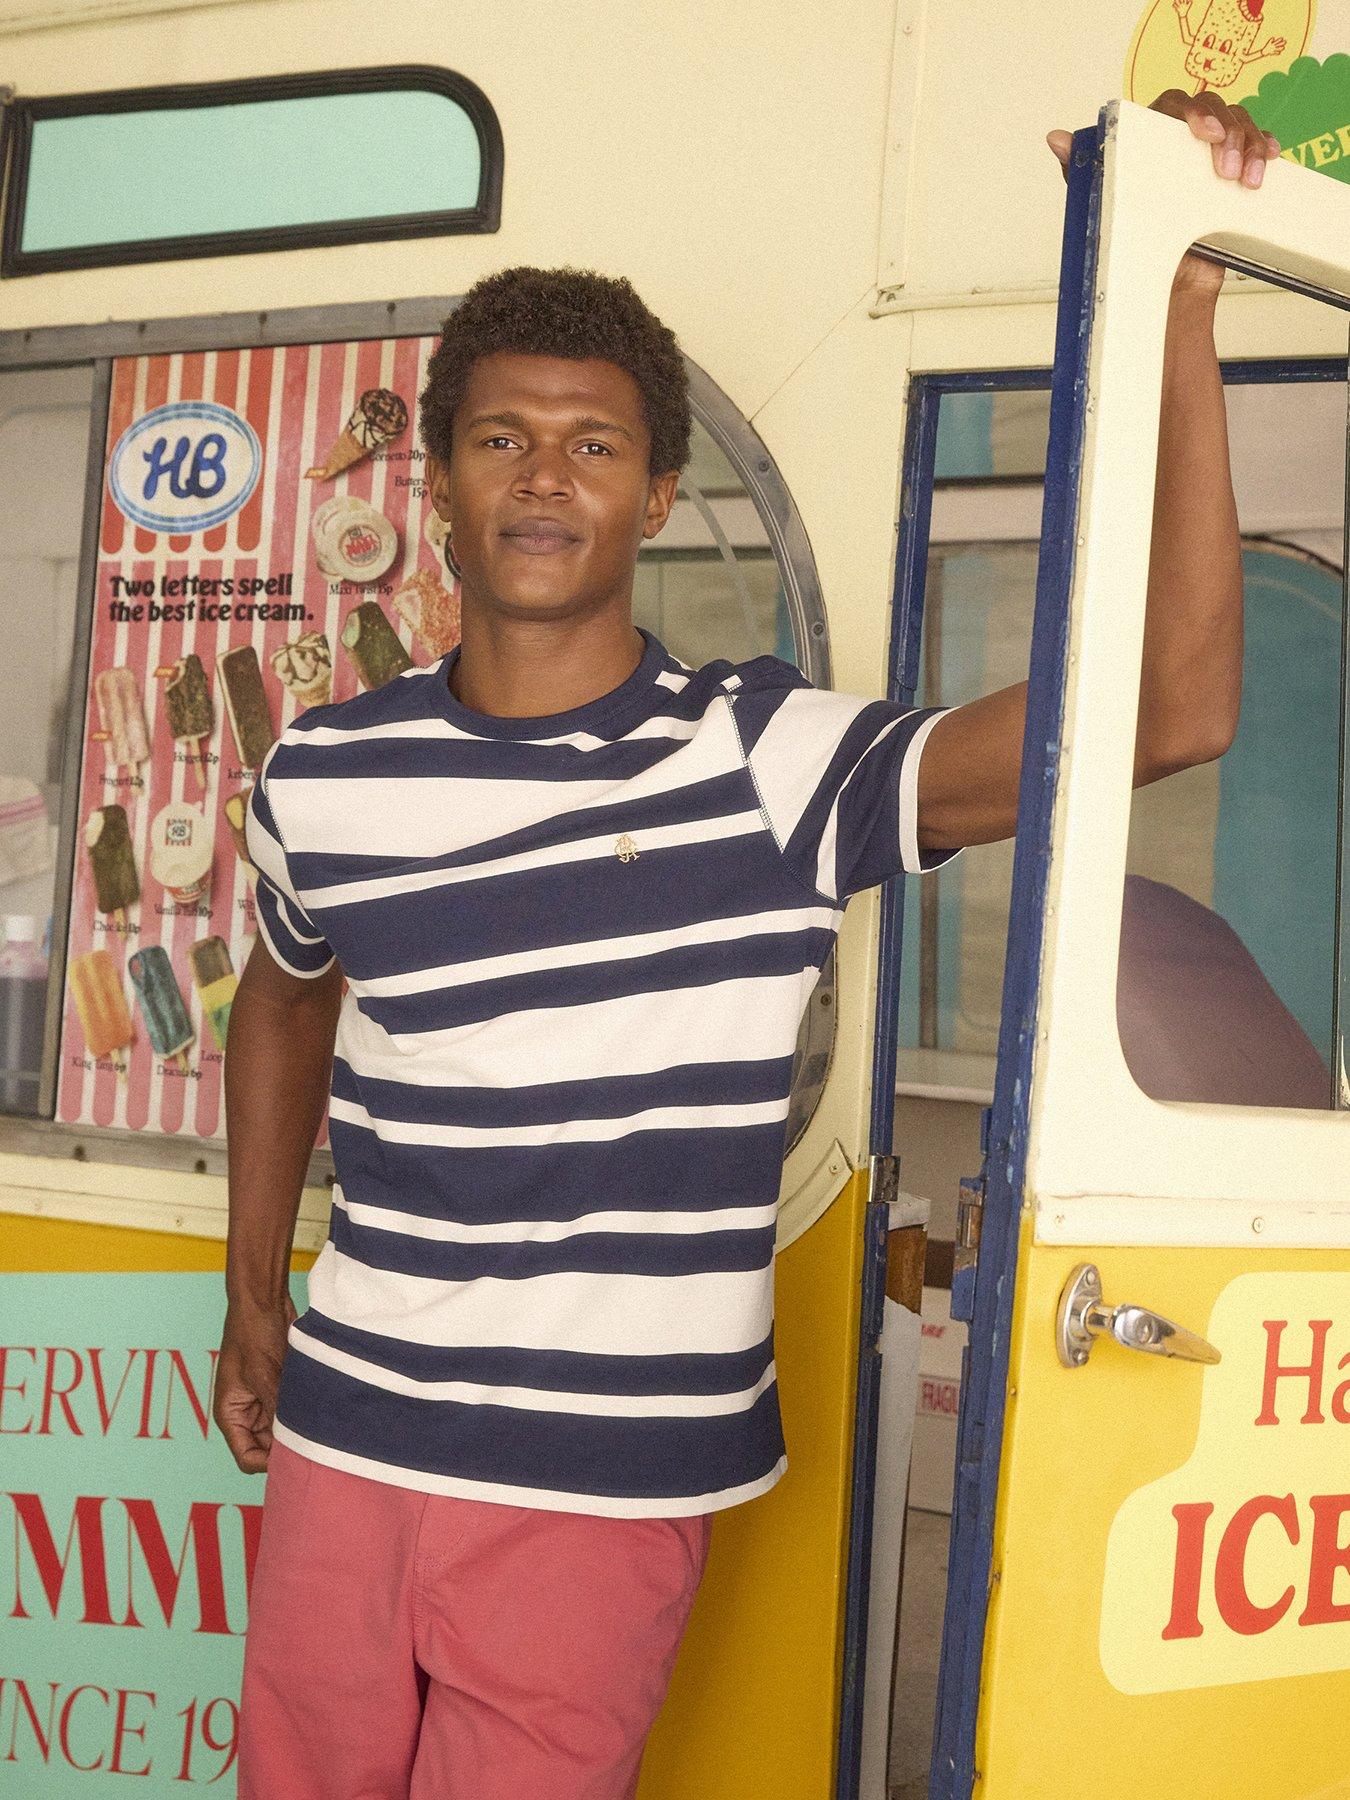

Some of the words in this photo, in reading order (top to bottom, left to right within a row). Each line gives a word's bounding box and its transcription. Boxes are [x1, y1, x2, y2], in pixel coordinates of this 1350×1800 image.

[142, 433, 227, 500] HB
[412, 487, 428, 500] 15p
[110, 575, 155, 597] Two
[161, 574, 234, 597] letters
[237, 573, 293, 597] spell
[109, 600, 144, 622] the
[147, 600, 196, 622] best
[199, 598, 232, 622] ice
[234, 602, 314, 622] cream.
[1161, 1492, 1350, 1641] ICE
[0, 1677, 158, 1777] NCE
